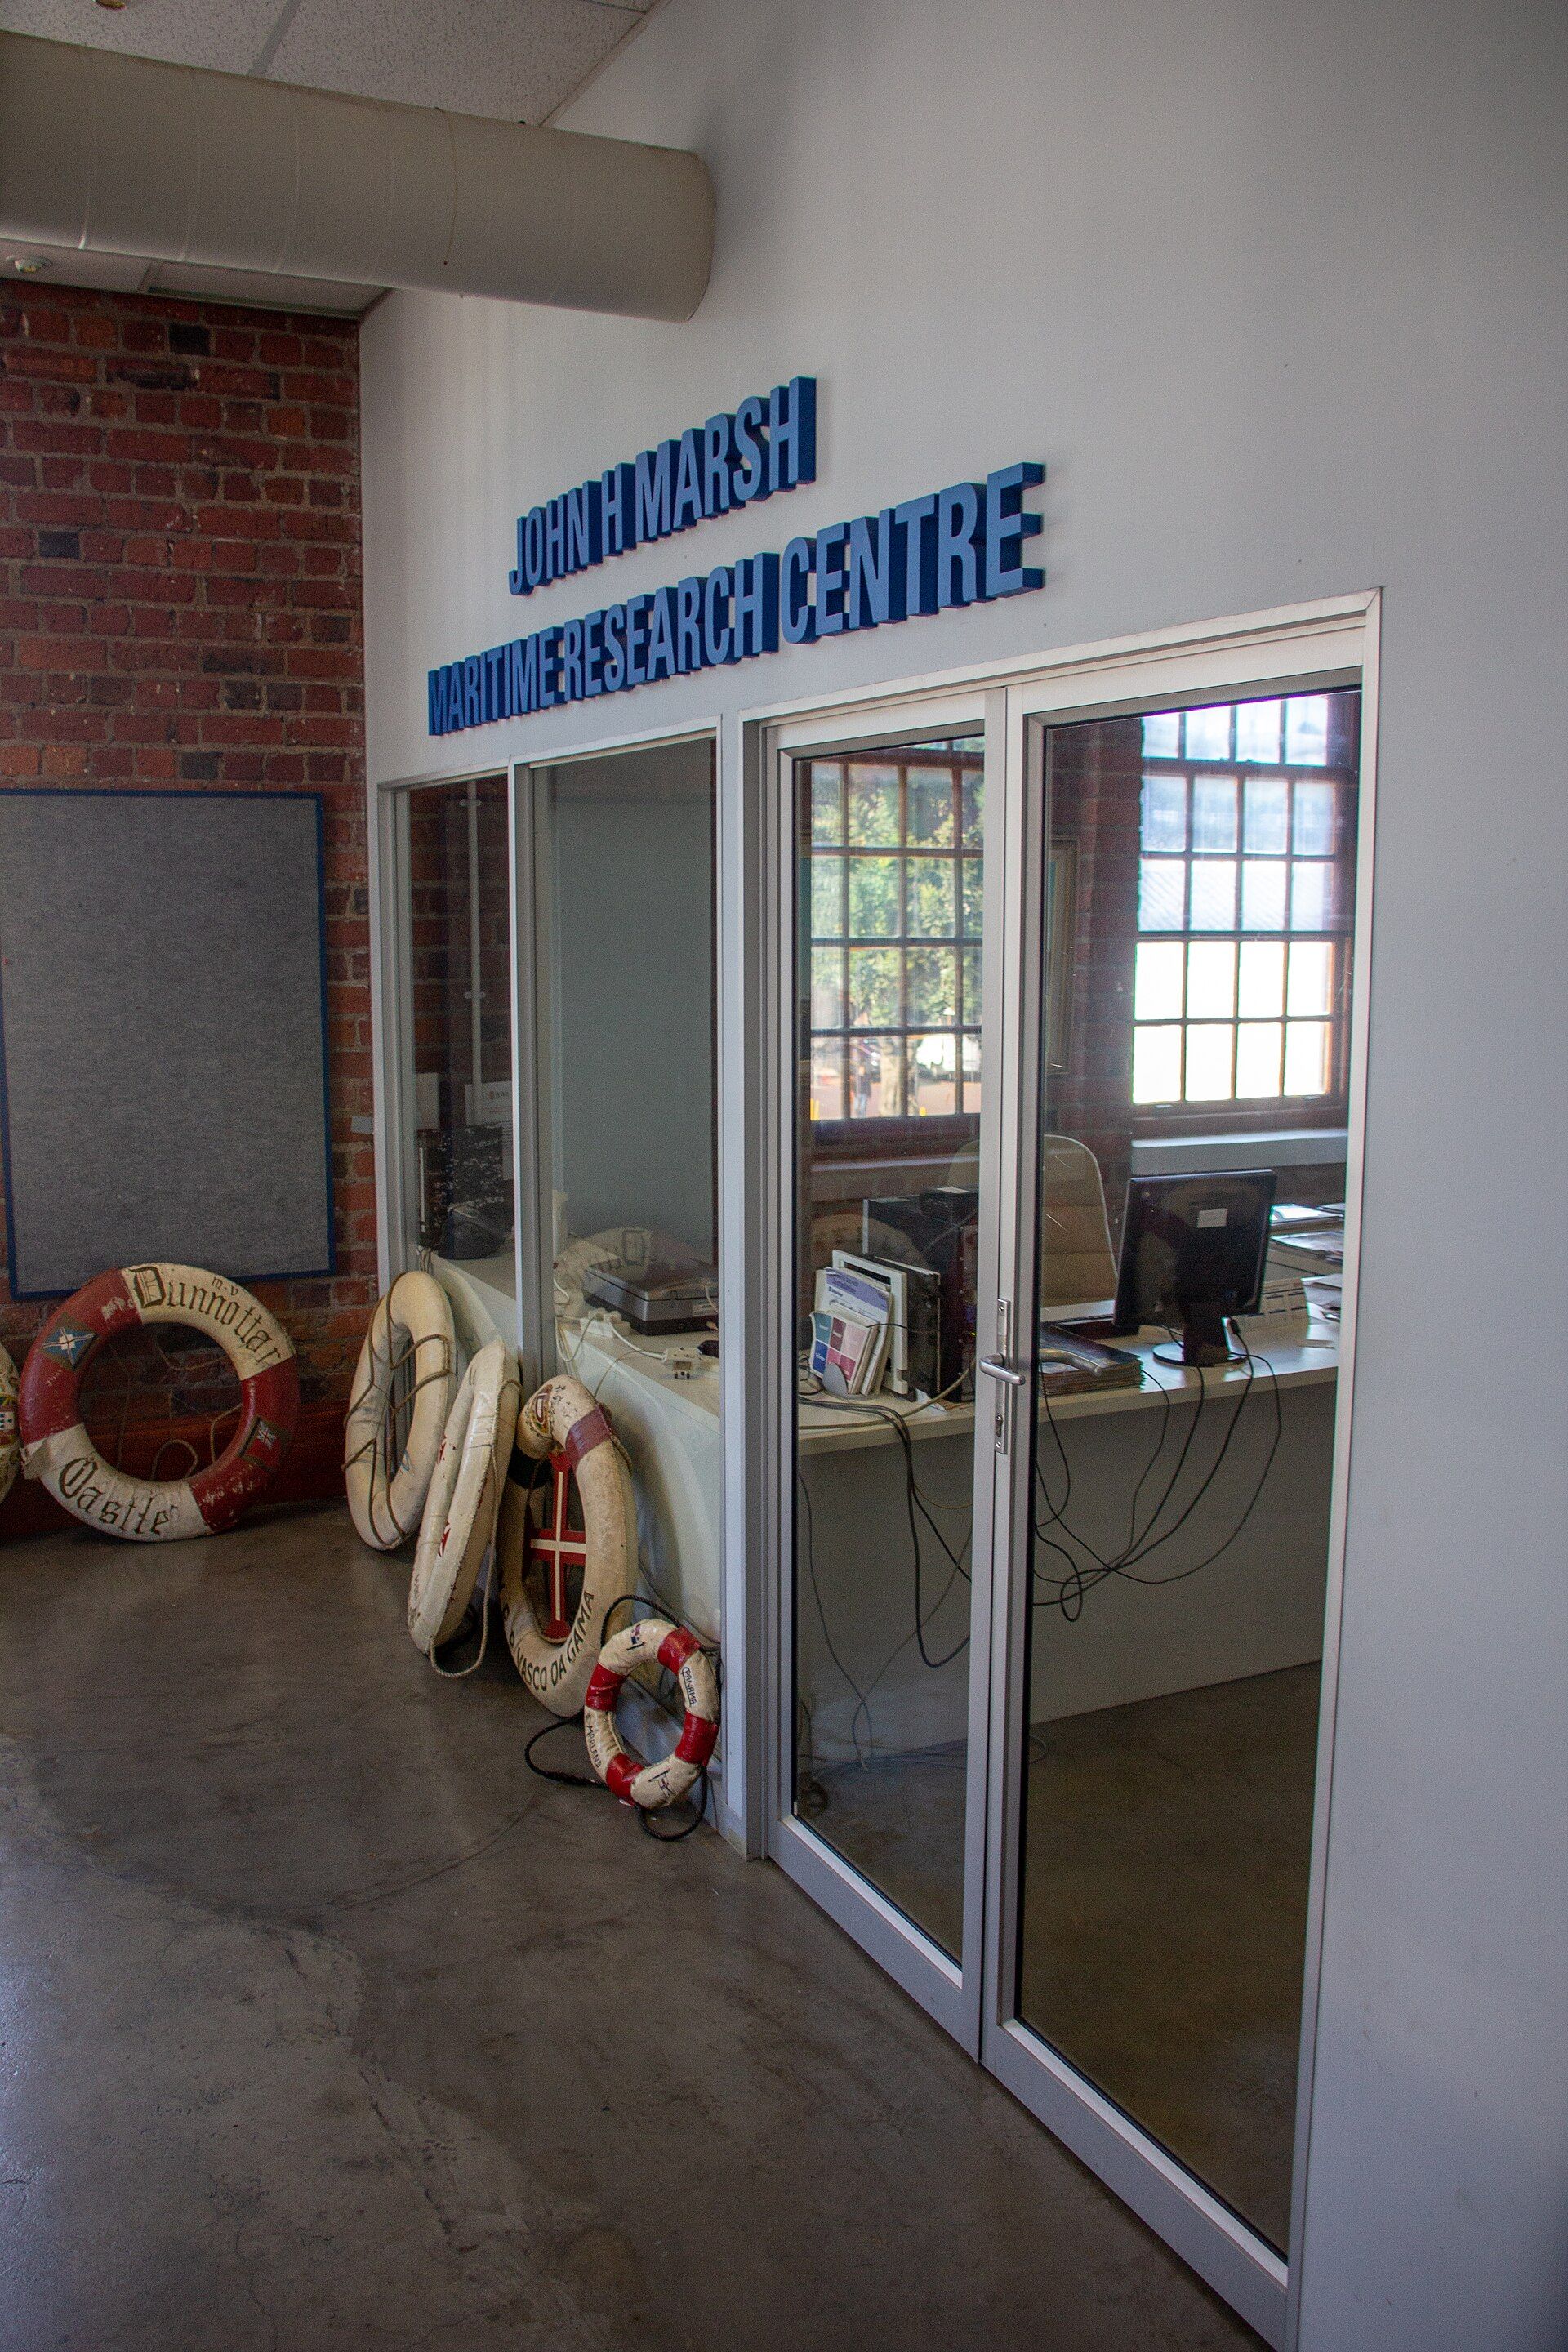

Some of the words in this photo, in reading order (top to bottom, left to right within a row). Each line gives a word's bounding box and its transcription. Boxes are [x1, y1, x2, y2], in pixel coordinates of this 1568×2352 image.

[509, 480, 603, 595] JOHN
[601, 461, 636, 556] H
[635, 376, 817, 542] MARSH
[428, 626, 565, 736] MARITIME
[564, 551, 780, 700] RESEARCH
[780, 461, 1045, 644] CENTRE
[59, 1457, 178, 1534] Castle
[516, 1647, 547, 1691] VASCO
[567, 1591, 595, 1664] GAMA
